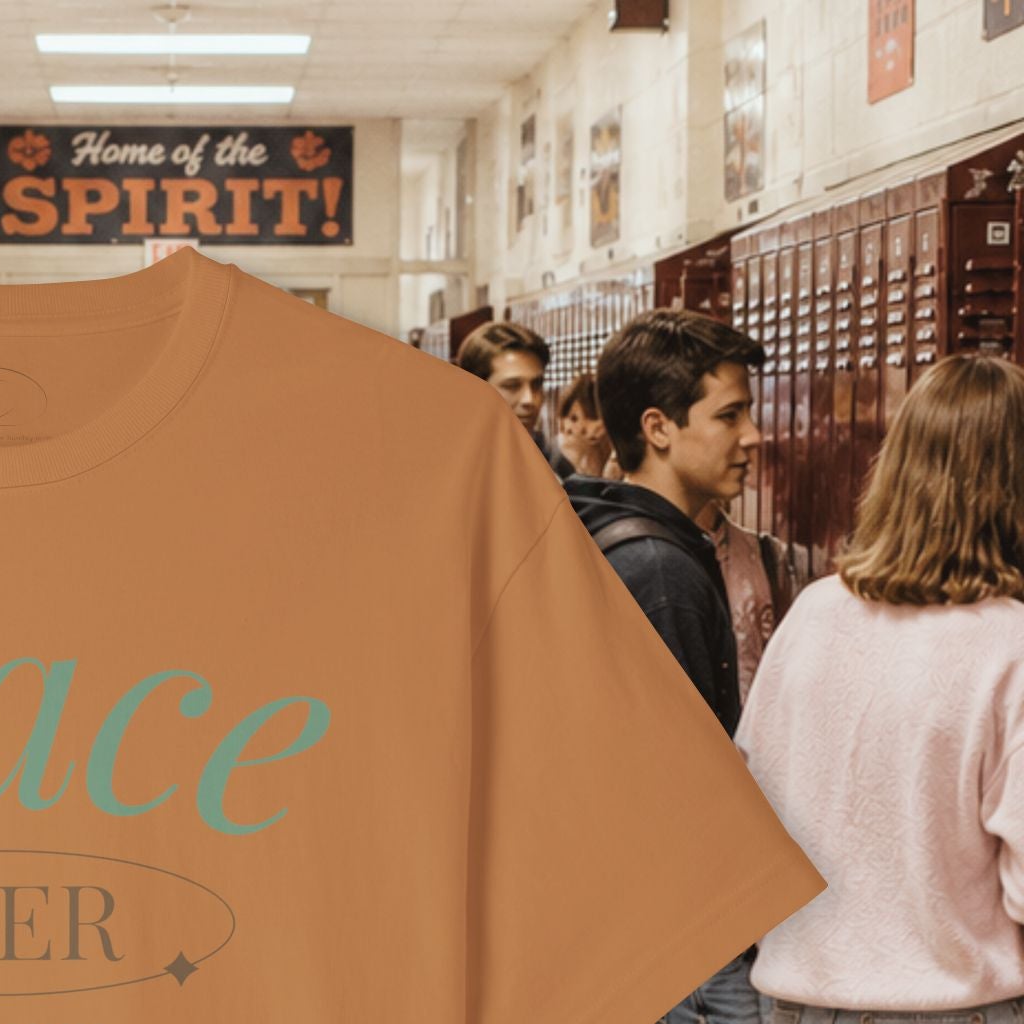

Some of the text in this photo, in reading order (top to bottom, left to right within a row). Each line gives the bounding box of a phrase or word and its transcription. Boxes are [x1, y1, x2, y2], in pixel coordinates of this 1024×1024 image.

[72, 131, 268, 175] Home of the
[1, 176, 343, 237] SPIRIT!
